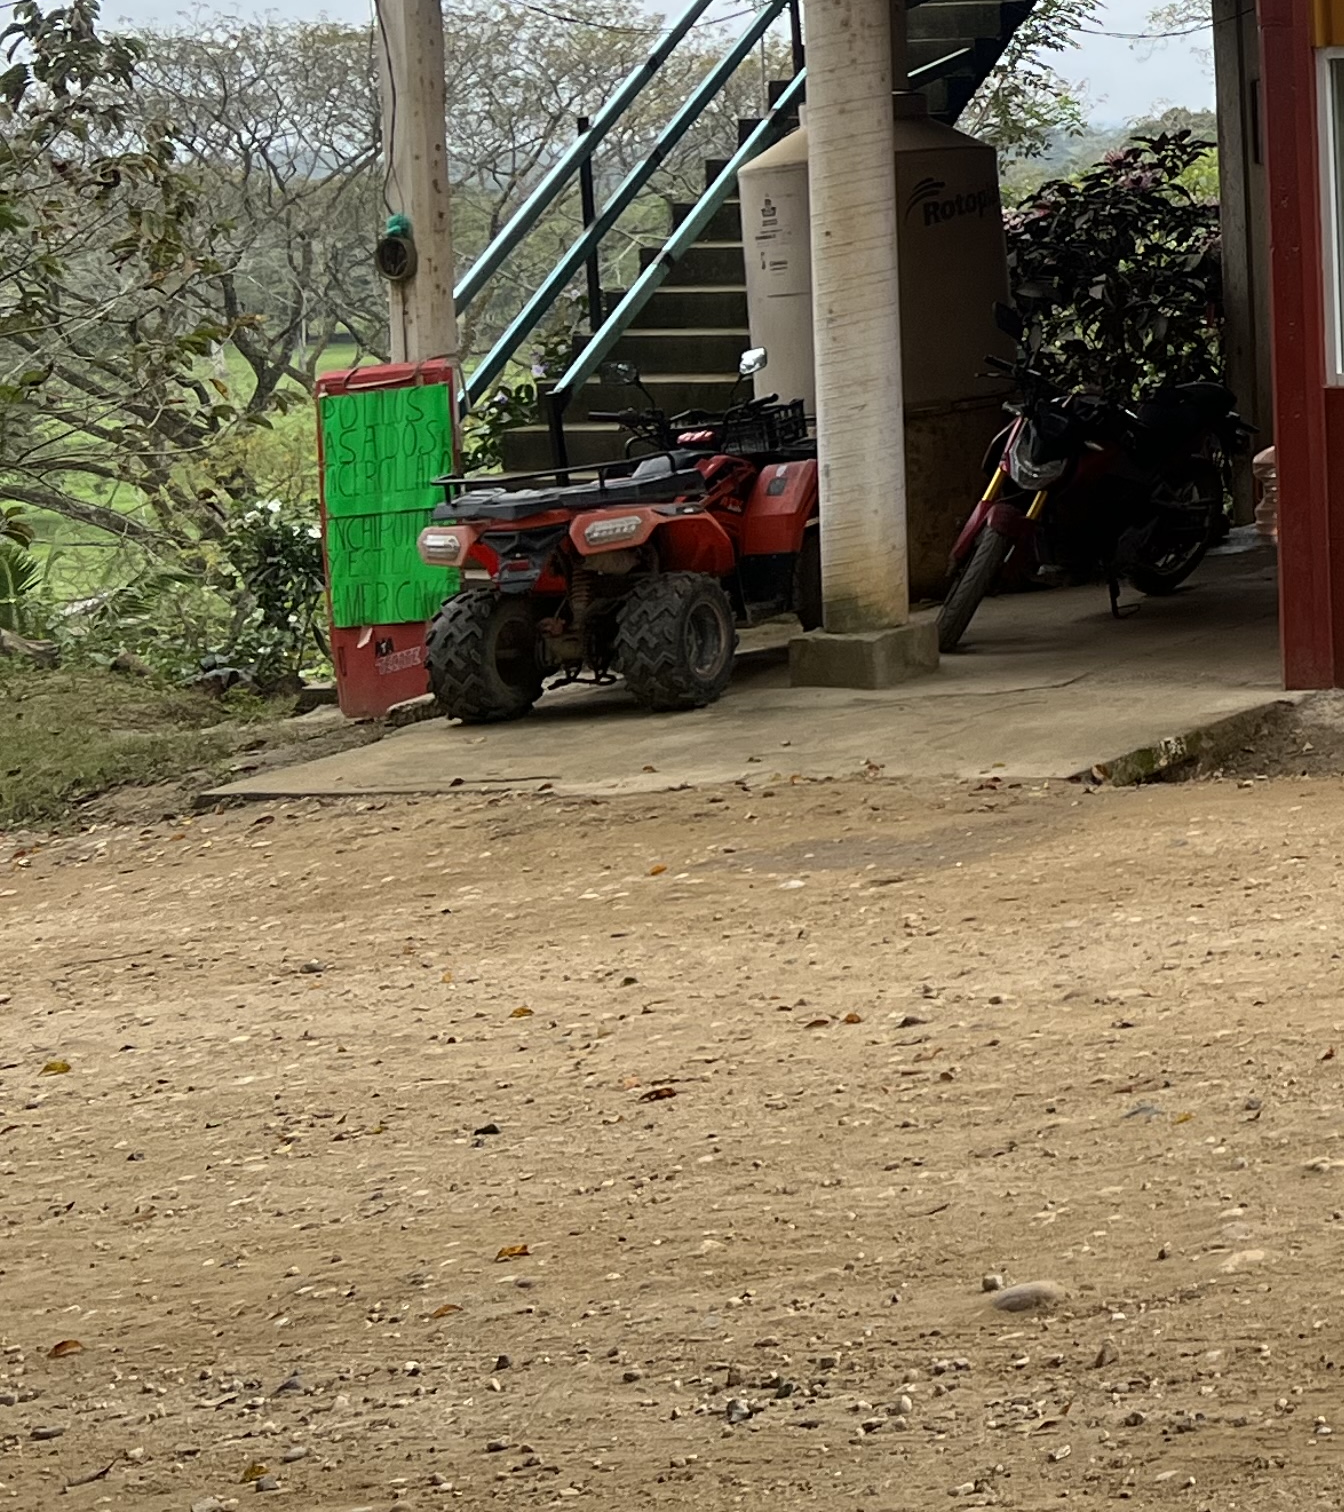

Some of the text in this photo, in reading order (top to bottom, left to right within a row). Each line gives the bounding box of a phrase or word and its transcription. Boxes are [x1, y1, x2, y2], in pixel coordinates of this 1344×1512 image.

[321, 386, 425, 430] POLLOS
[326, 546, 413, 579] Y ESTILO
